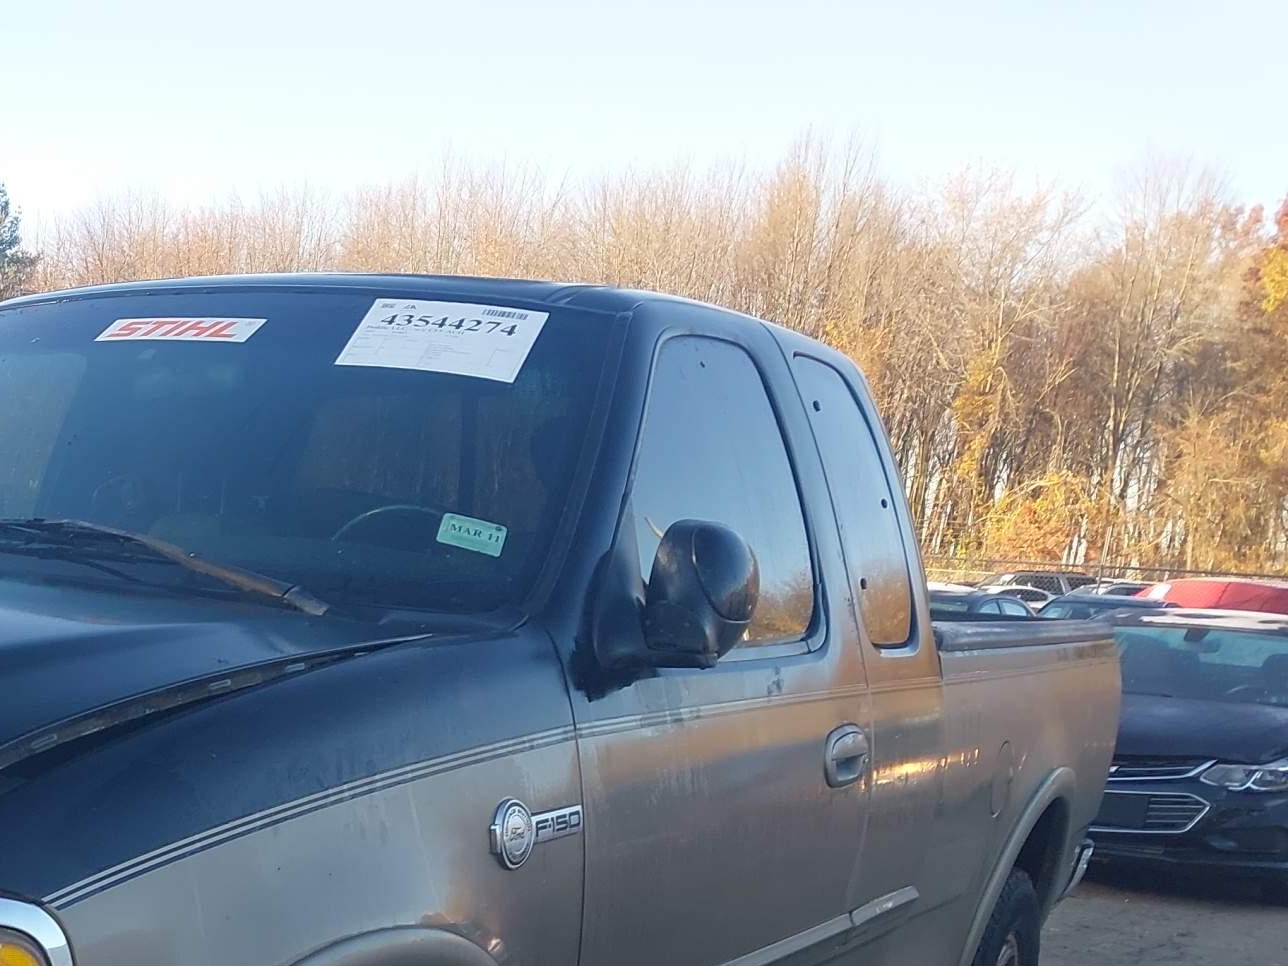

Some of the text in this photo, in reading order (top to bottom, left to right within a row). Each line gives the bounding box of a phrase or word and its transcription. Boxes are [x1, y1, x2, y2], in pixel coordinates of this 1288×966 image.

[105, 319, 239, 339] STIHL
[380, 313, 519, 337] 43544274
[451, 524, 482, 538] MAR
